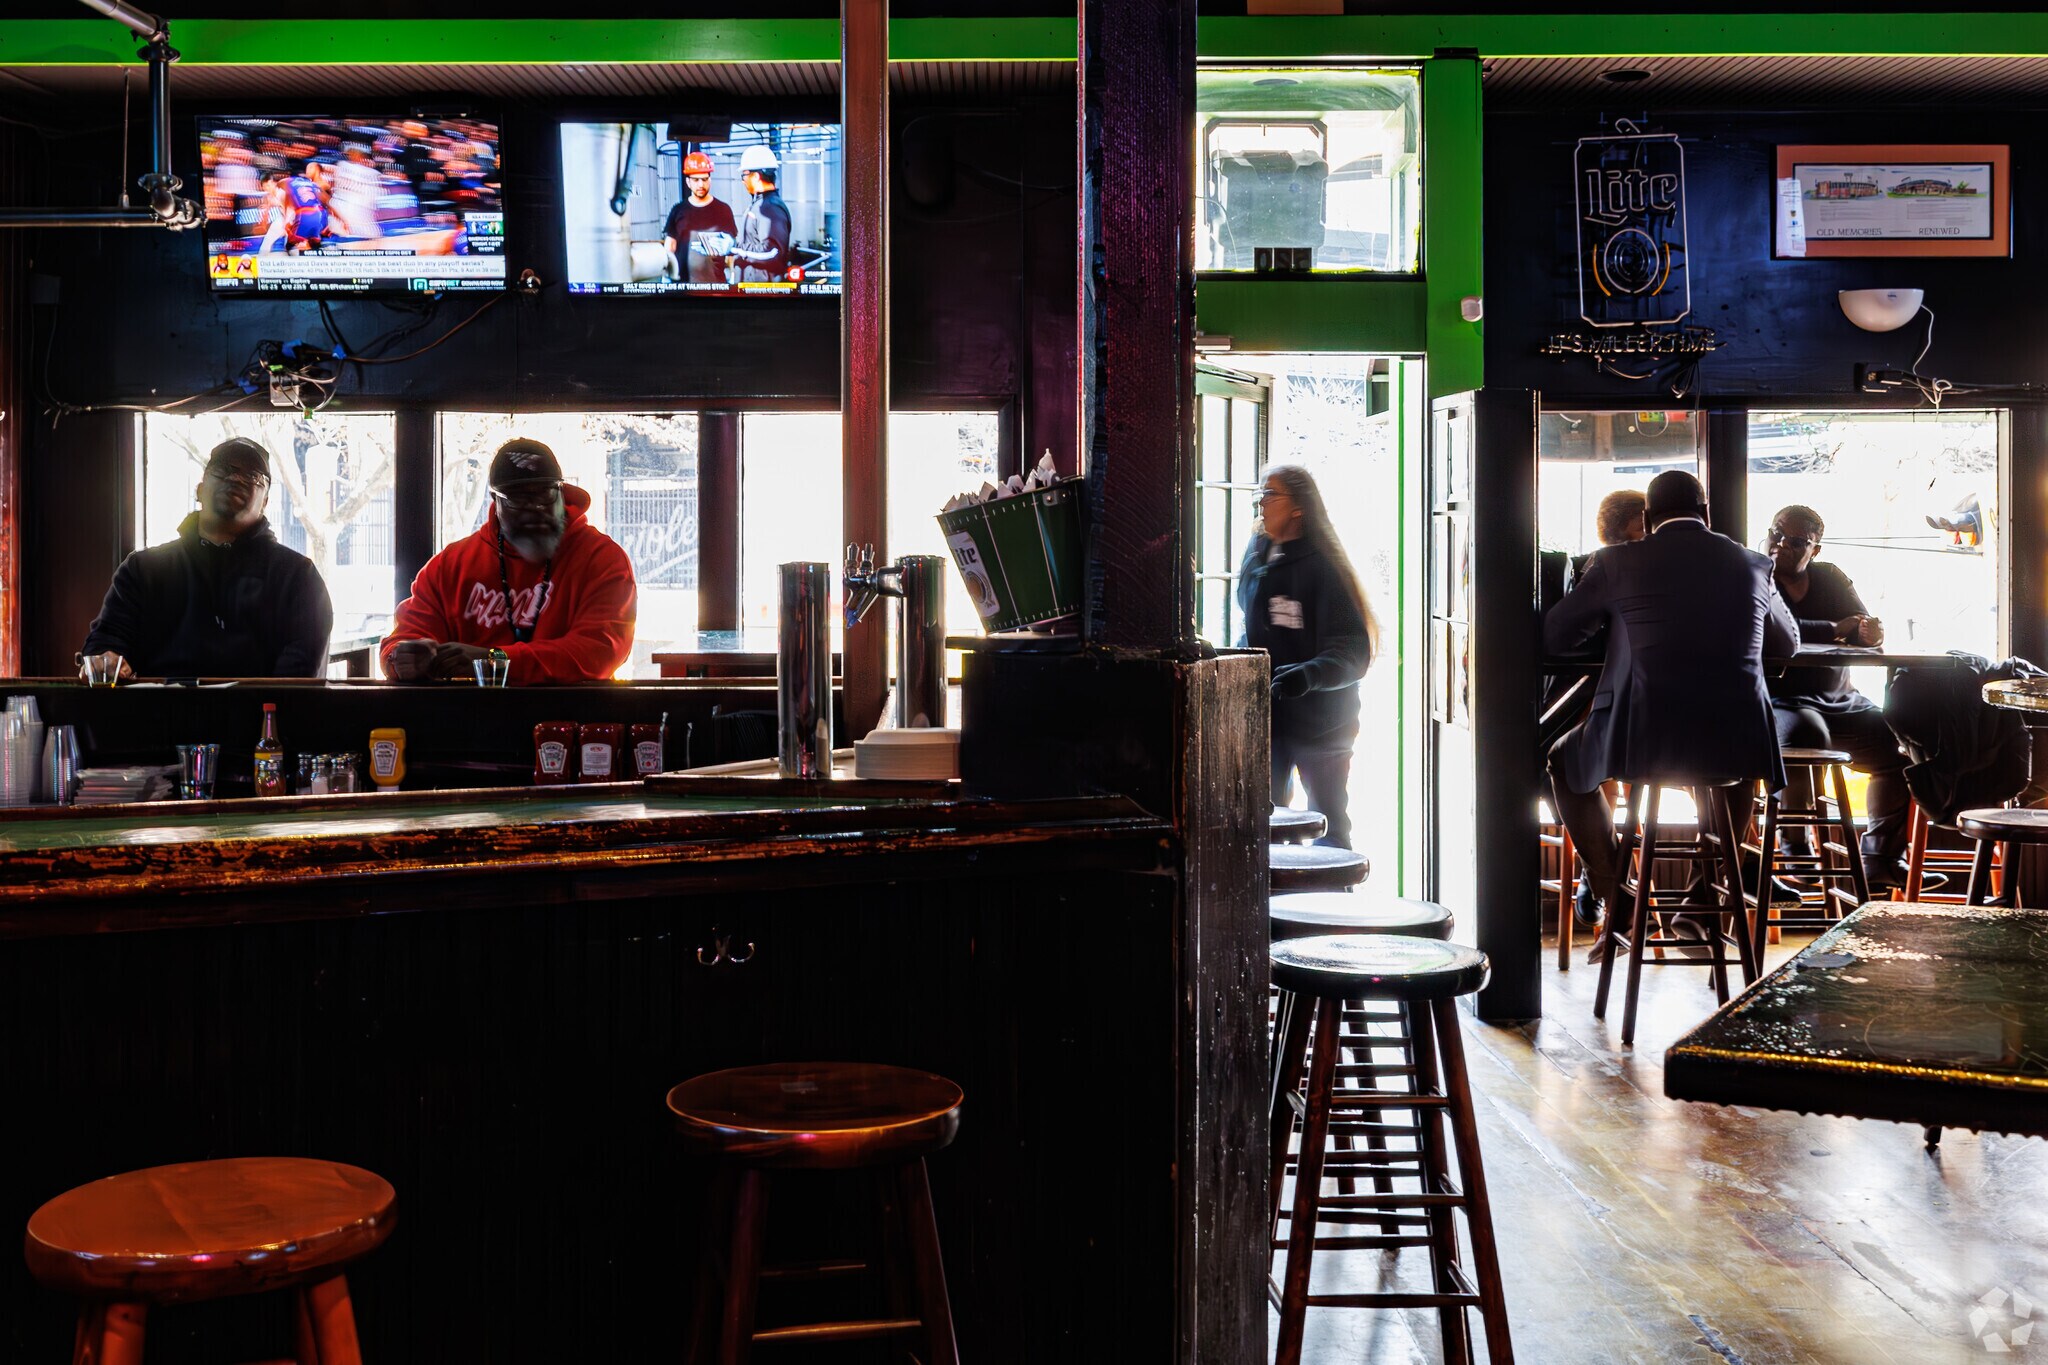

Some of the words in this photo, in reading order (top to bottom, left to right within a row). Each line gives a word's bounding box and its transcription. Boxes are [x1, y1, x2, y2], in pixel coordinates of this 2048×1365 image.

[1584, 169, 1678, 227] Lite
[1816, 228, 1834, 236] OLD
[1838, 228, 1882, 236] MEMORIES
[1919, 227, 1960, 236] RENEWED
[216, 278, 239, 287] ESPN
[1549, 333, 1582, 353] IT'S
[1589, 333, 1664, 353] MILLER
[1664, 329, 1716, 352] TIME
